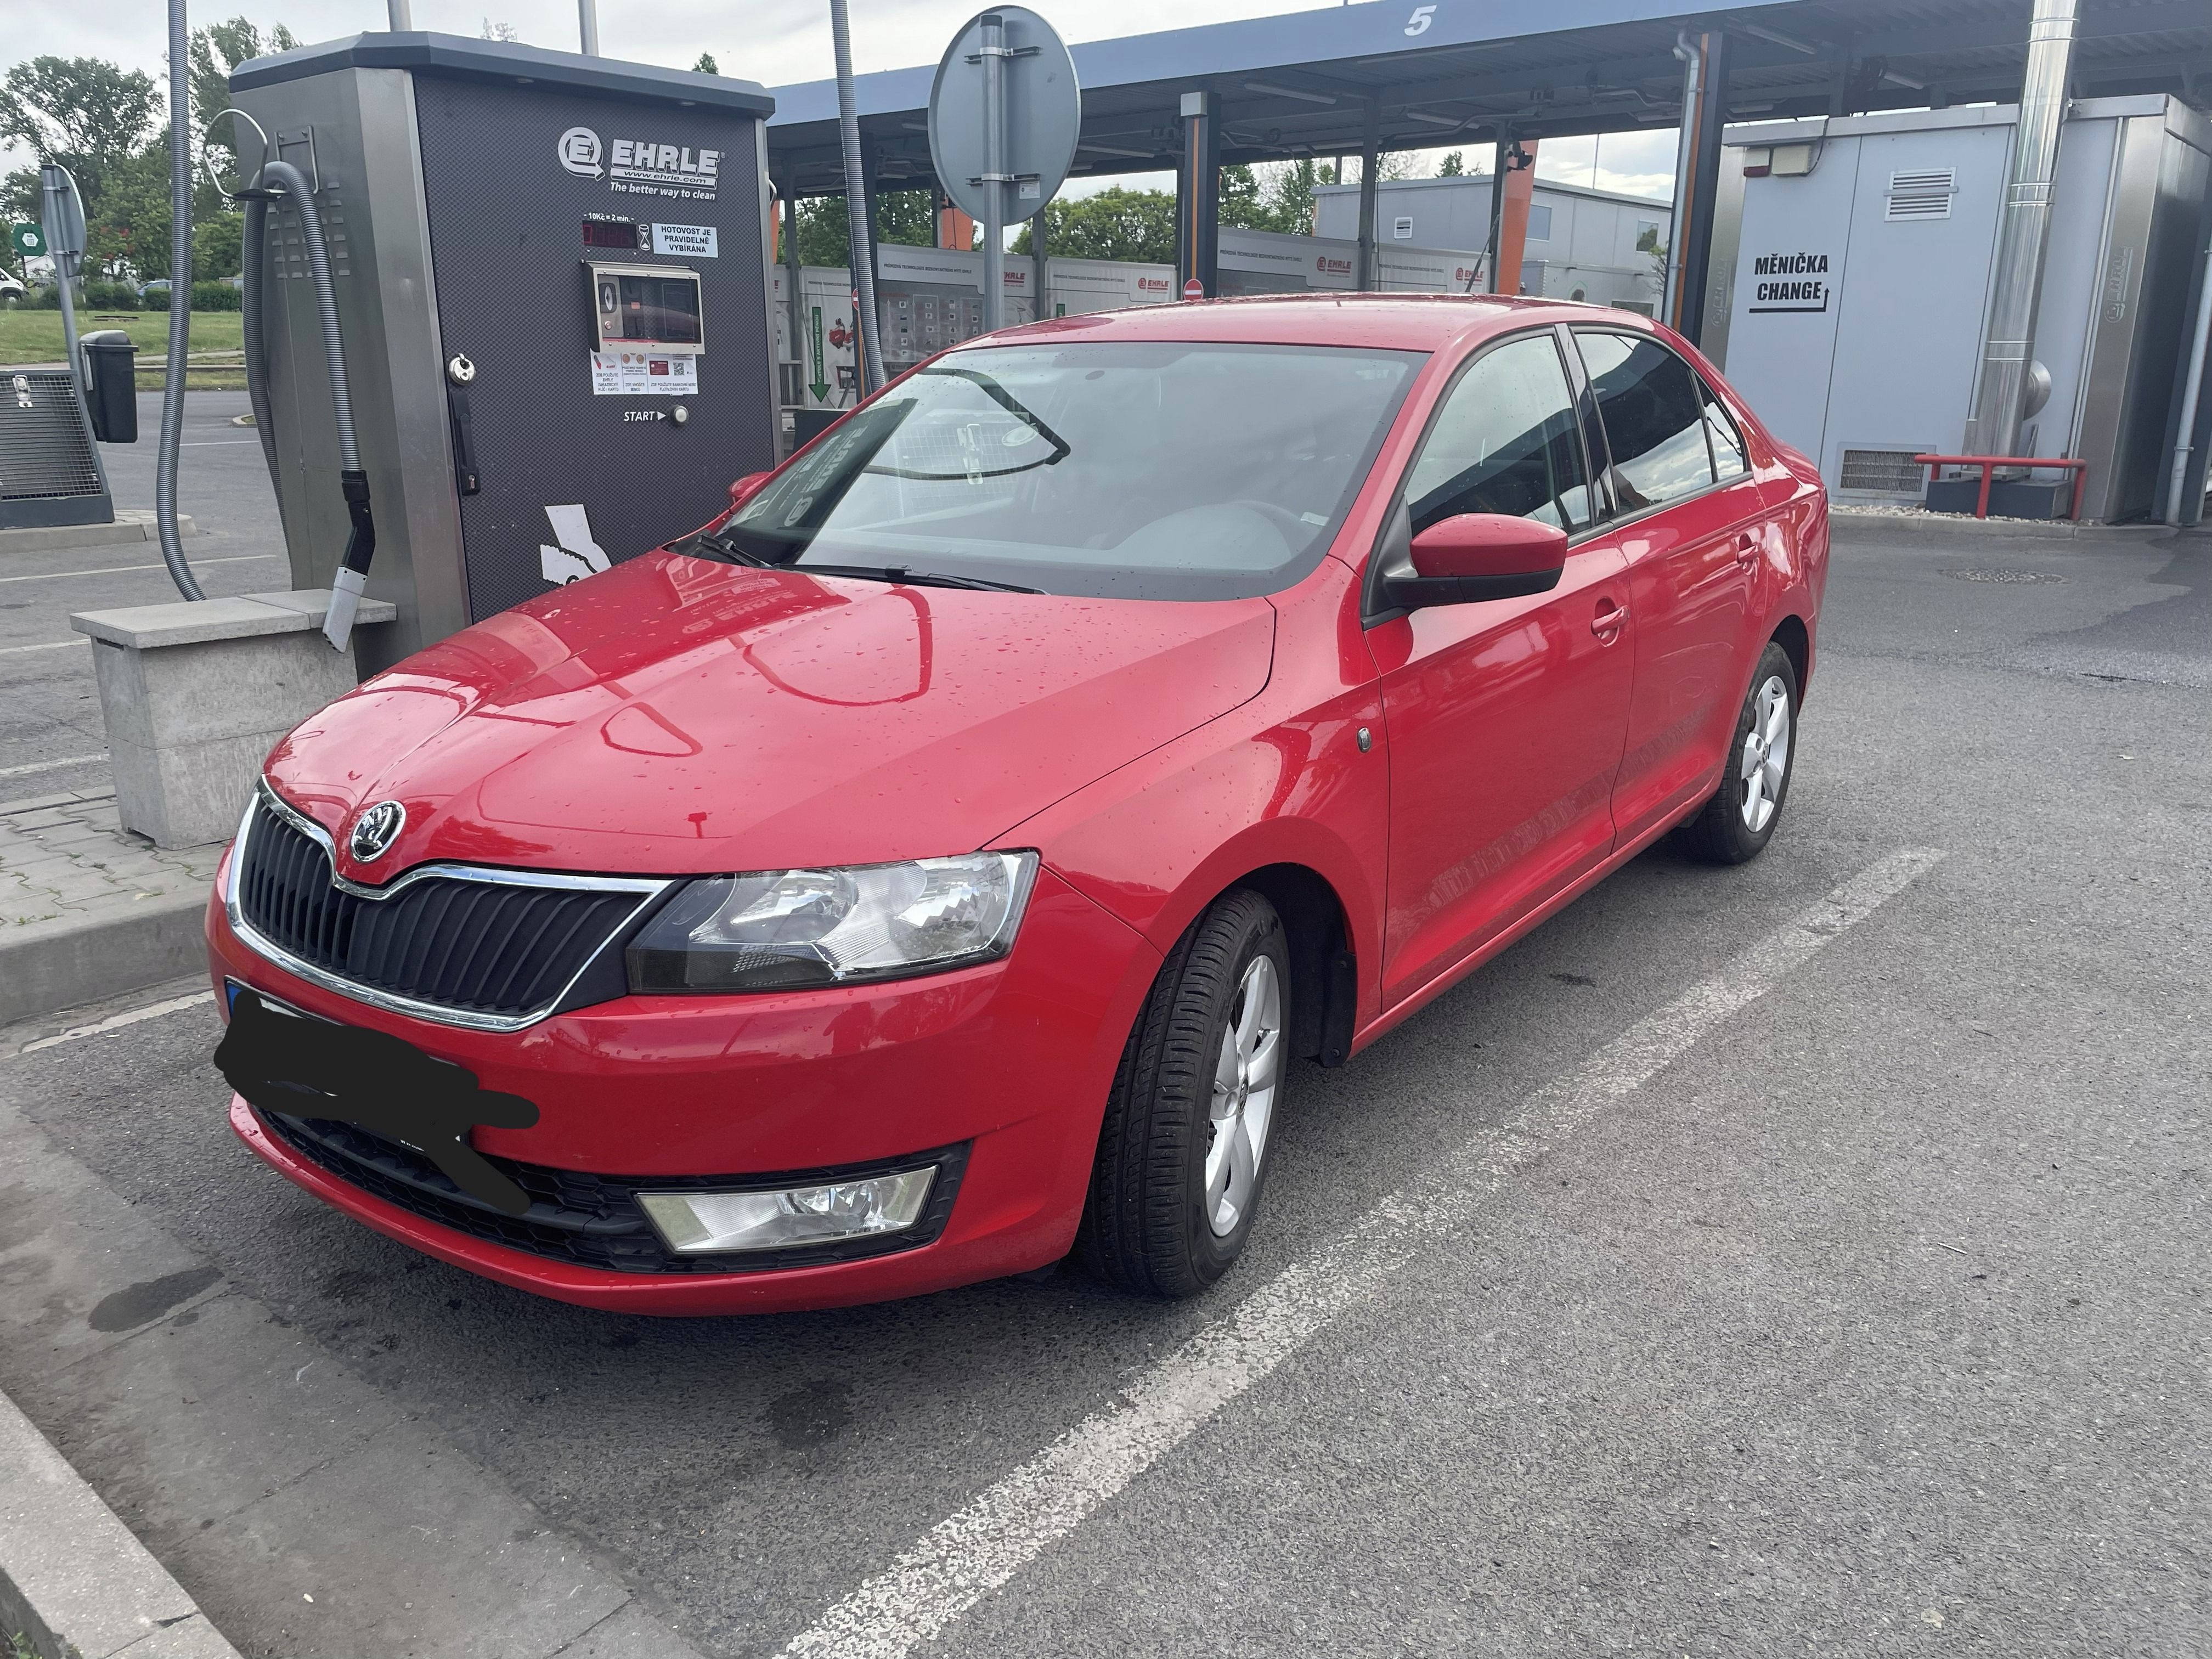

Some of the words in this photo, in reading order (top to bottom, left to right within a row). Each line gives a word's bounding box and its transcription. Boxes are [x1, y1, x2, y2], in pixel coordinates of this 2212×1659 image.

[1404, 4, 1437, 36] 5
[611, 139, 720, 178] EHRLE
[624, 171, 707, 184] www.ehrle.com
[610, 182, 627, 192] The
[629, 183, 658, 195] better
[660, 188, 679, 199] way
[681, 189, 691, 198] to
[692, 190, 715, 201] clean
[661, 225, 701, 236] HOTOVOST
[702, 228, 712, 236] JE
[664, 235, 710, 245] PRAVIDELNĚ
[669, 244, 707, 253] VYBÍRÁNA
[1327, 259, 1352, 270] EHRLE
[1754, 252, 1829, 275] MĚNIČKA
[1004, 272, 1025, 280] HRLE
[1147, 279, 1169, 287] EHRLE
[1757, 281, 1822, 301] CHANGE
[624, 411, 655, 422] START
